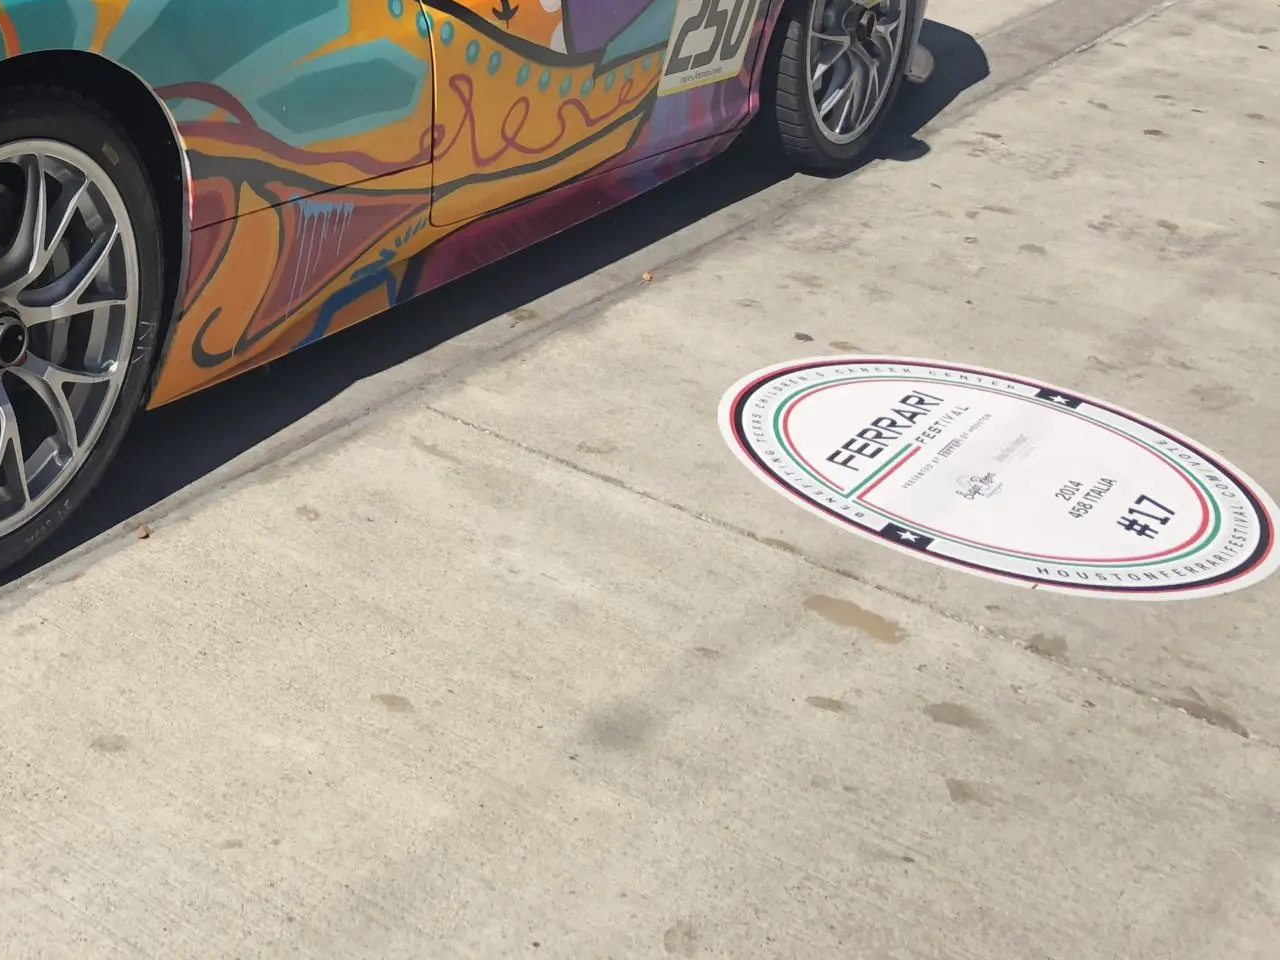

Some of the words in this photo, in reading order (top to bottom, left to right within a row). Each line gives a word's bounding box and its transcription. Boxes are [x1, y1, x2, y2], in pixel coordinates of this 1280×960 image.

[834, 366, 913, 376] CANCER
[927, 369, 1017, 391] CENTER
[751, 413, 768, 444] TEXAS
[825, 389, 945, 472] FERRARI
[914, 405, 971, 445] FESTIVAL
[764, 449, 866, 519] BENEFITING
[1054, 480, 1084, 502] 2014
[1067, 500, 1094, 520] 458
[1082, 477, 1118, 504] ITALIA
[1116, 494, 1176, 540] #17
